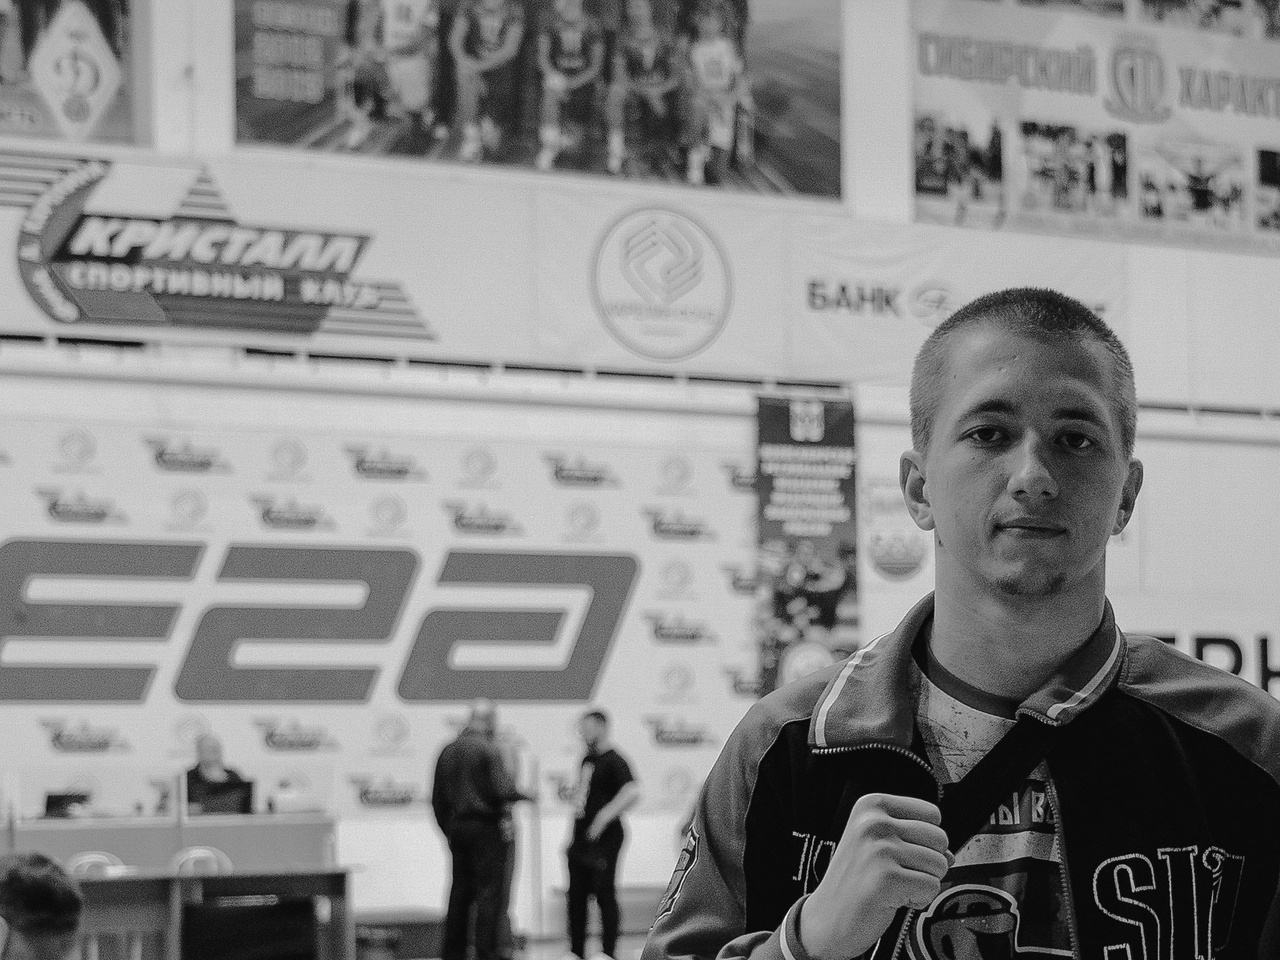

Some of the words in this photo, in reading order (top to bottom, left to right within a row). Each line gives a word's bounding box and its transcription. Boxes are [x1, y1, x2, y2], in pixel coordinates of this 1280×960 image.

[69, 217, 360, 273] КРИСТАЛЛ
[69, 263, 285, 301] СПОРТИВНЫЙ
[807, 278, 901, 317] БАНК
